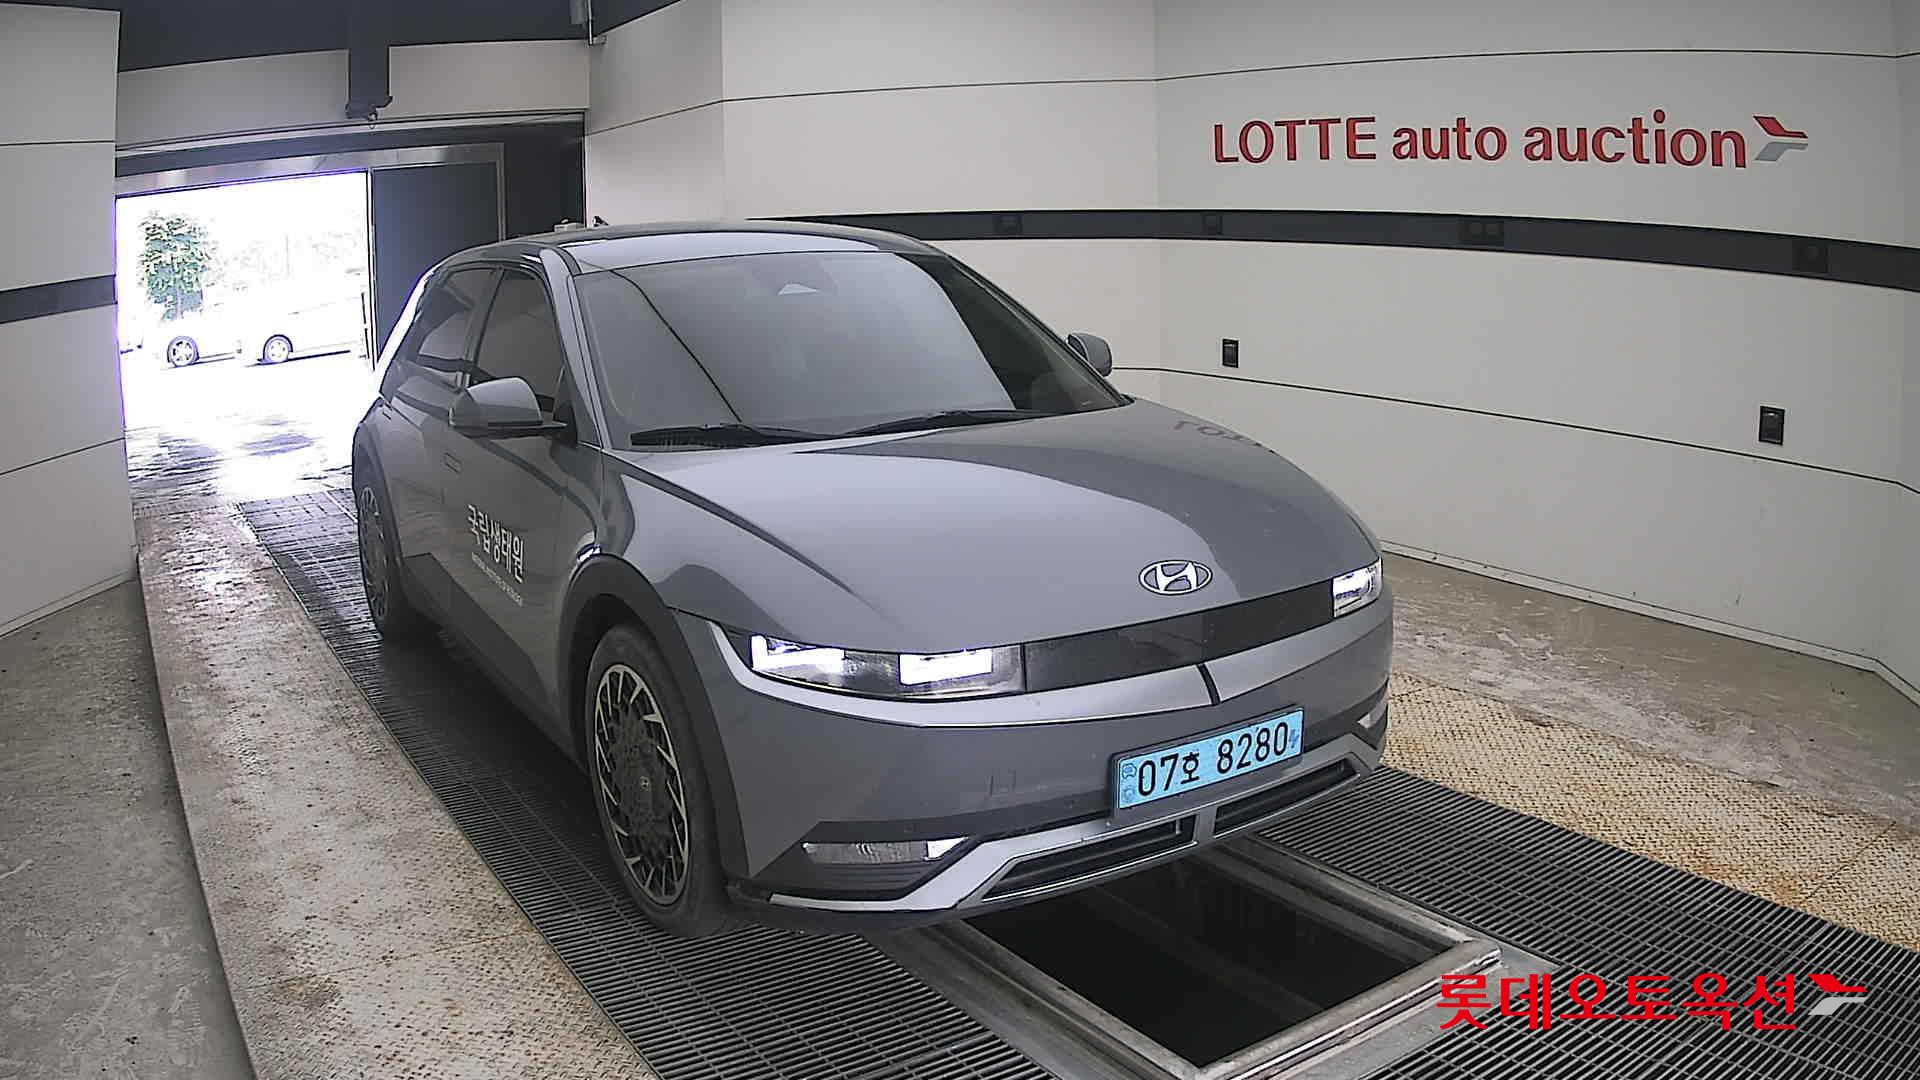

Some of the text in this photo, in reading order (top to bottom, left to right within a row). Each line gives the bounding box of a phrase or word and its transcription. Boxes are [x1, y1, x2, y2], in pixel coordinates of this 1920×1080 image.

[1213, 108, 1747, 169] LOTTE auto auction
[467, 504, 524, 584] 국립생태원
[1137, 721, 1289, 796] 07호 8280
